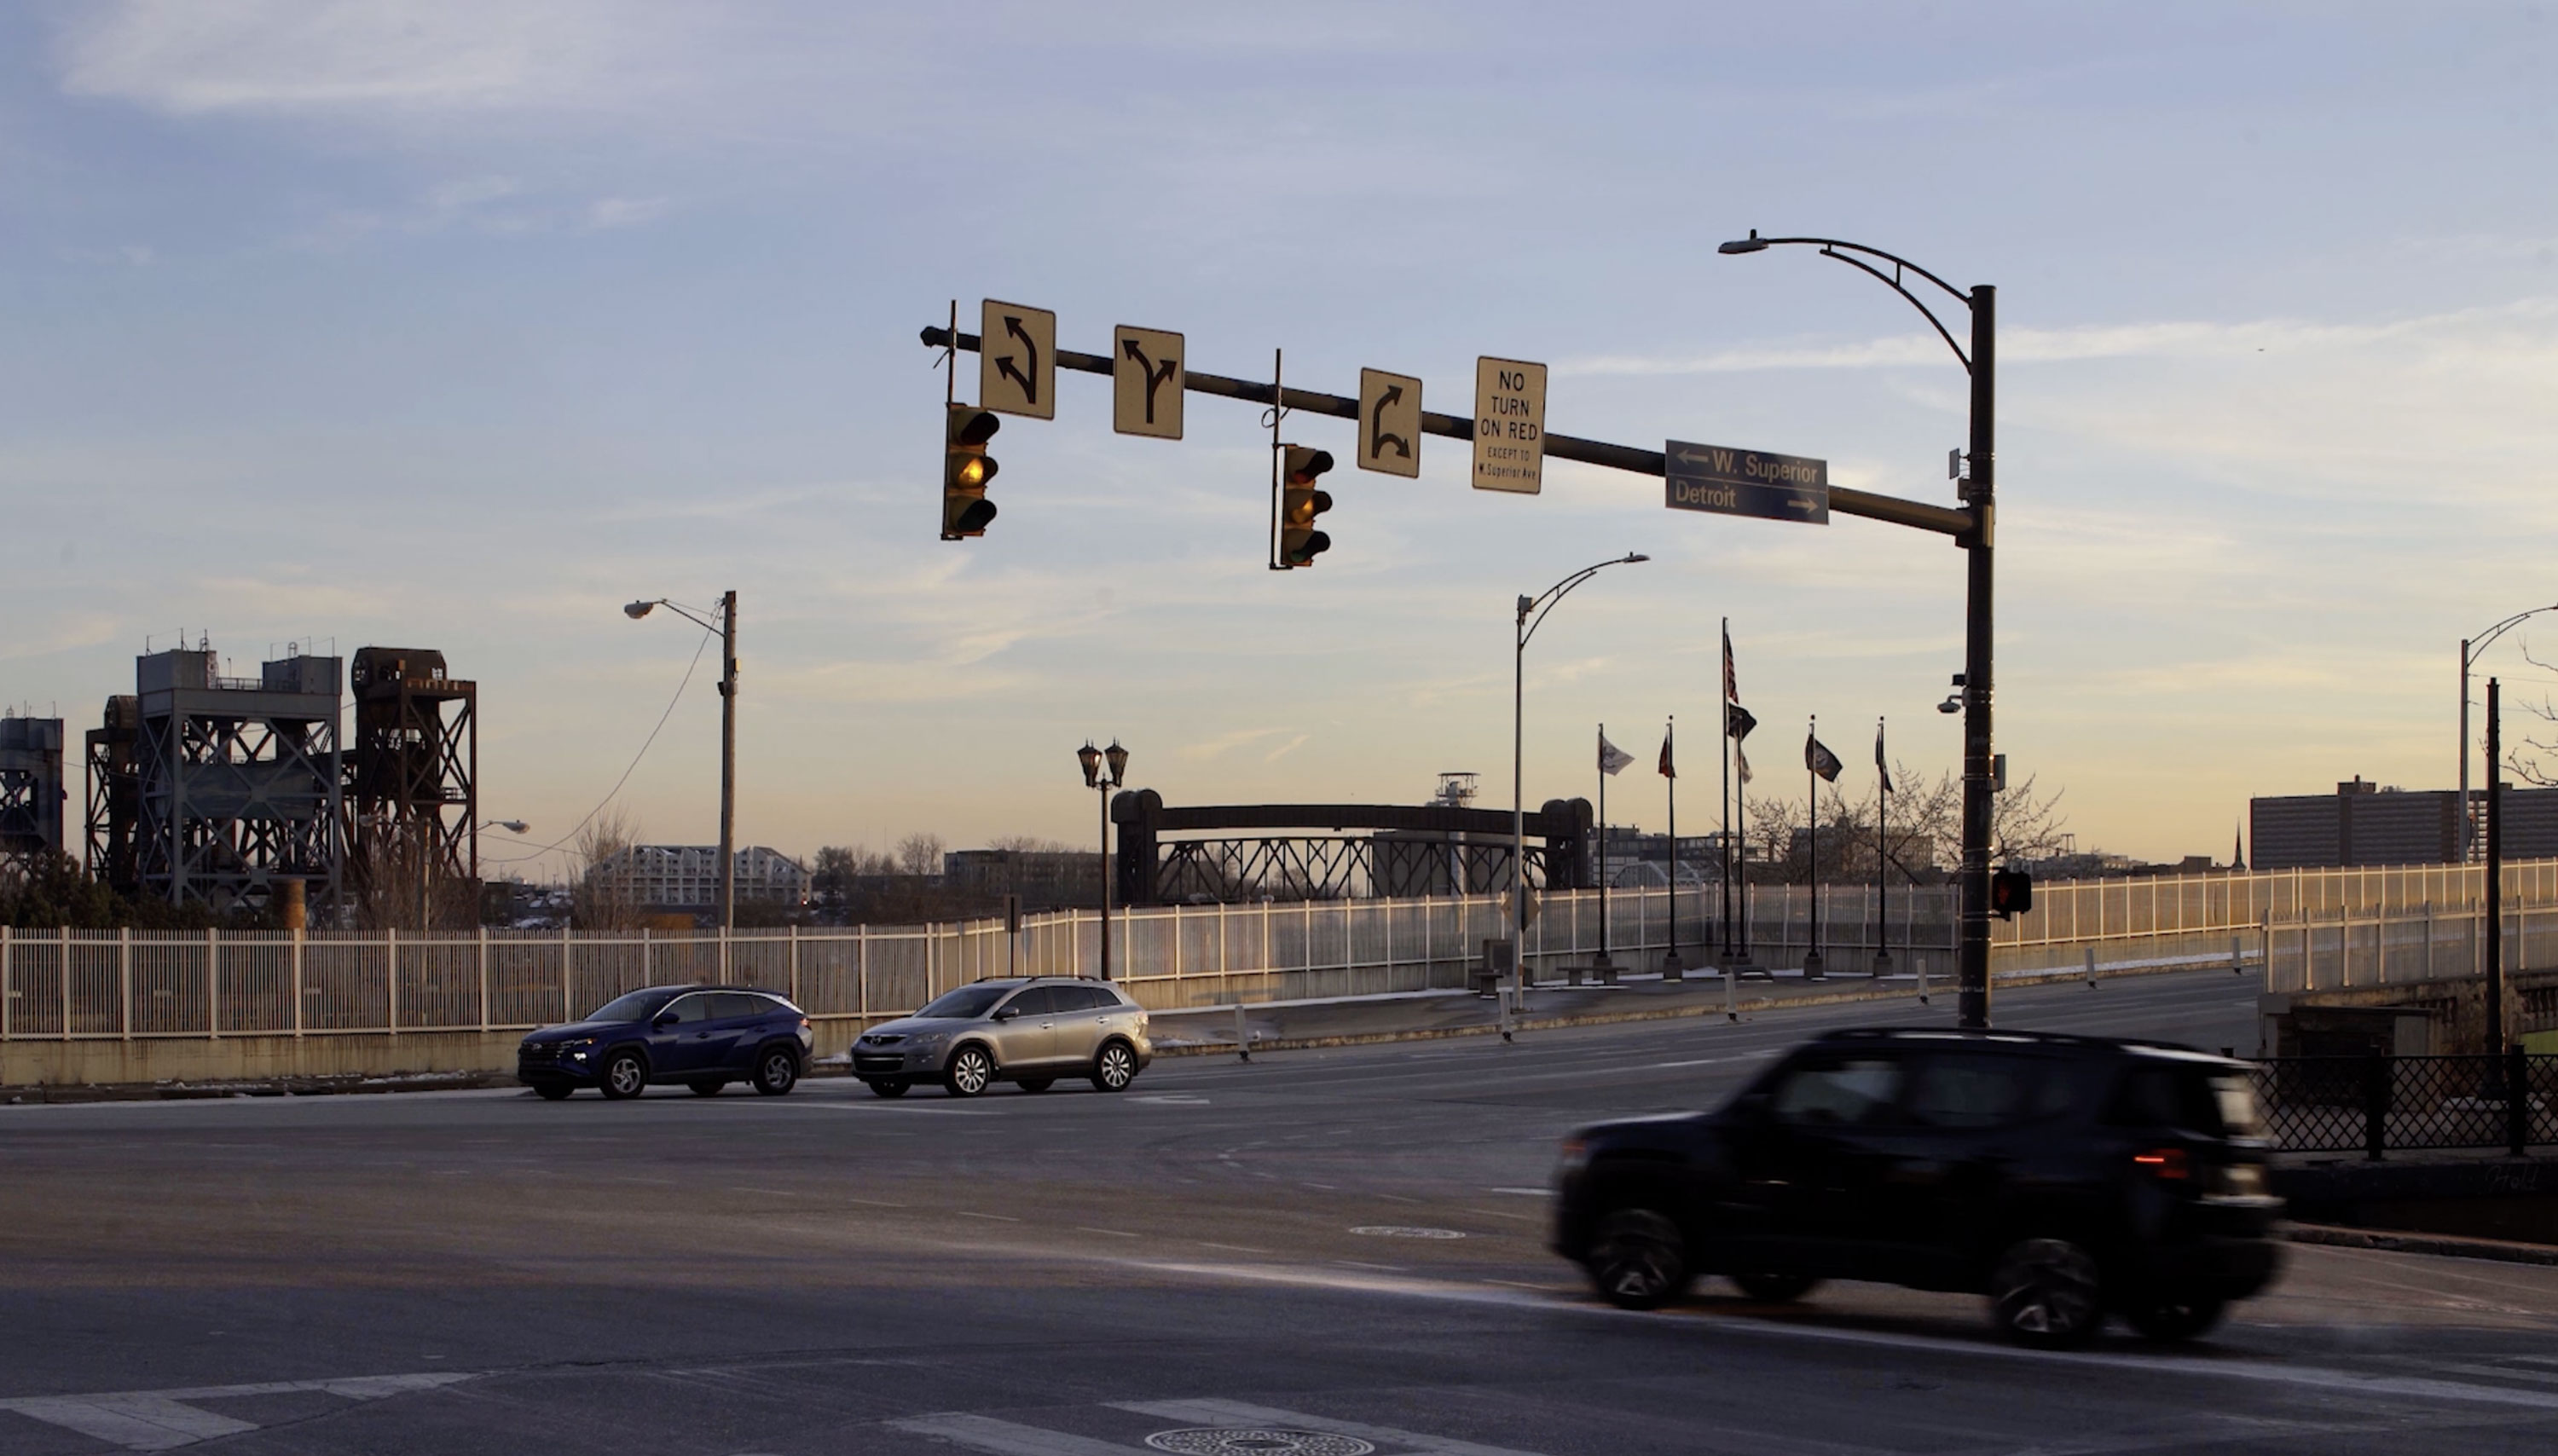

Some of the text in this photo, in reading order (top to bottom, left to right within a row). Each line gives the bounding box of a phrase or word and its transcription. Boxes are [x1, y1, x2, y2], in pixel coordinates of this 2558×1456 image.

[1499, 370, 1525, 392] NO
[1491, 396, 1530, 417] TURN
[1480, 419, 1537, 441] ON RED
[1487, 447, 1531, 461] EXCEPT TO
[1487, 463, 1520, 479] Superior
[1523, 466, 1537, 480] Ave
[1712, 449, 1818, 484] W. Superior
[1675, 480, 1737, 508] Detroit
